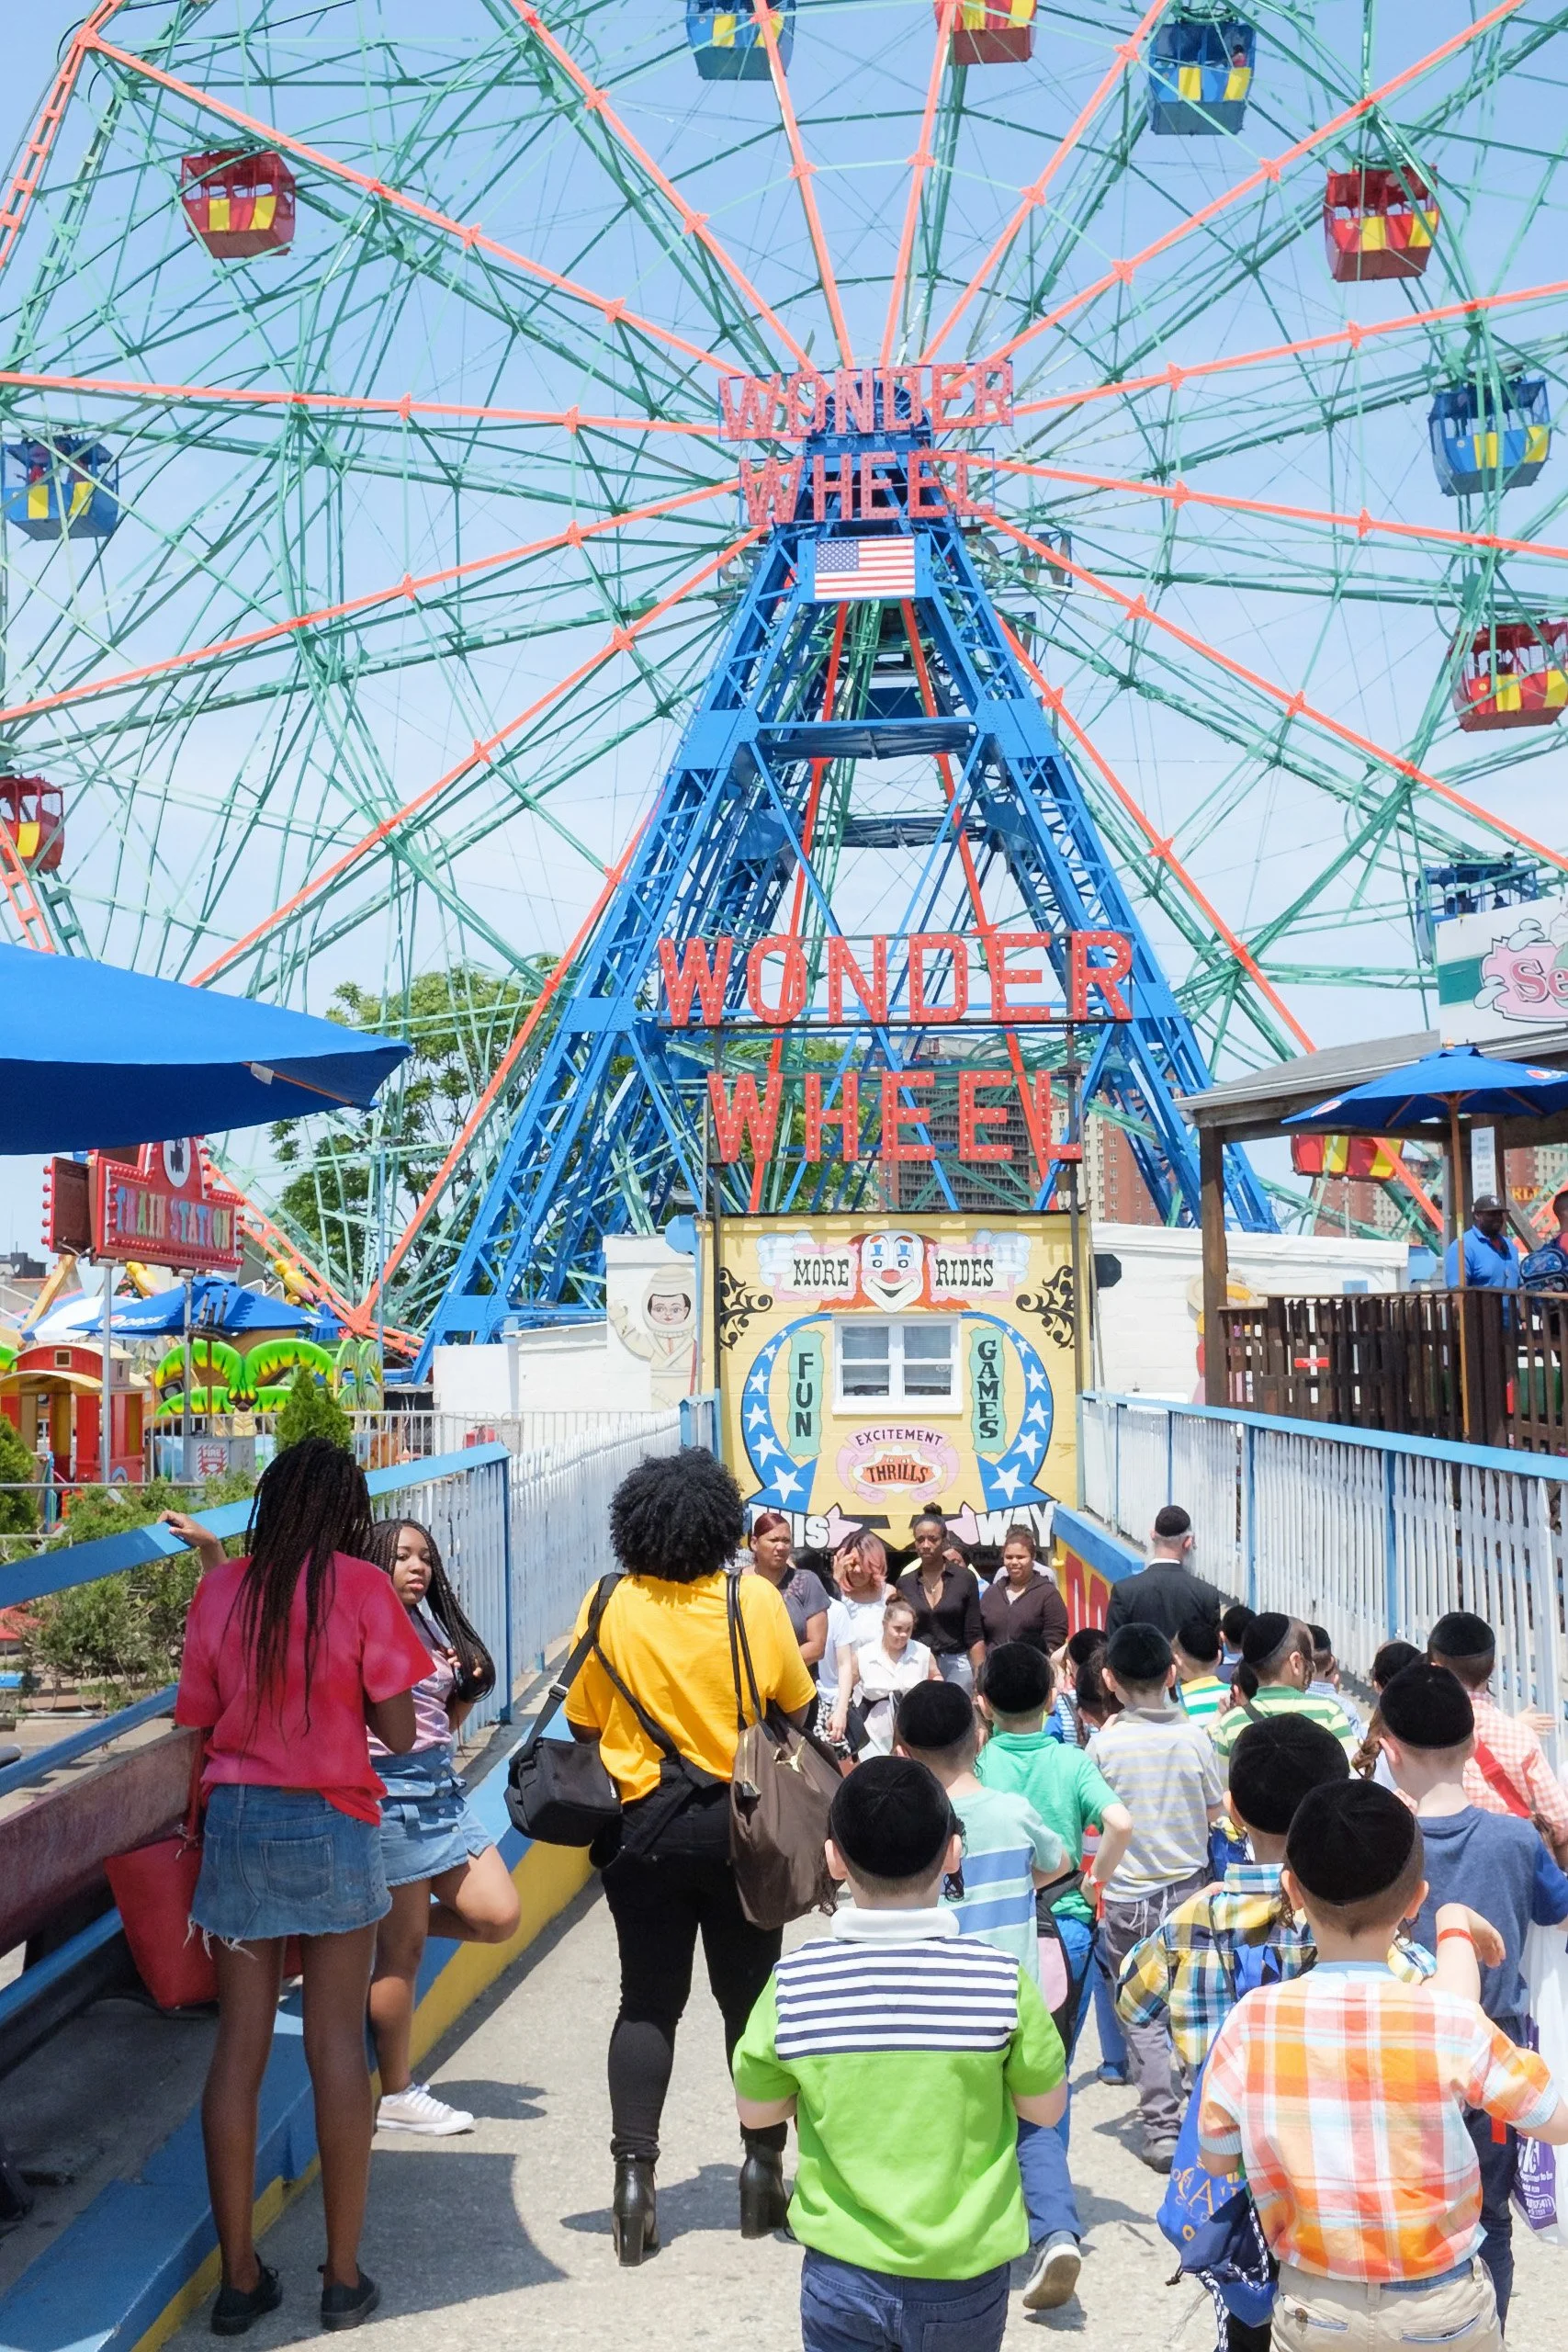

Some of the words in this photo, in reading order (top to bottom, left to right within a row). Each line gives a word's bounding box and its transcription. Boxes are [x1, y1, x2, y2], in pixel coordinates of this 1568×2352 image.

[719, 362, 1012, 441] WONDER
[740, 450, 995, 525] WHEEL
[659, 931, 1132, 1025] WONDER
[707, 1070, 1082, 1162] WHEEL
[794, 1259, 849, 1286] MORE
[936, 1259, 993, 1286] RIDES
[795, 1352, 814, 1437] FUN
[977, 1340, 998, 1439] GAMES
[202, 1448, 221, 1457] FIRE
[855, 1429, 942, 1446] EXCITEMENT
[866, 1464, 929, 1483] THRILLS
[749, 1503, 829, 1549] IS
